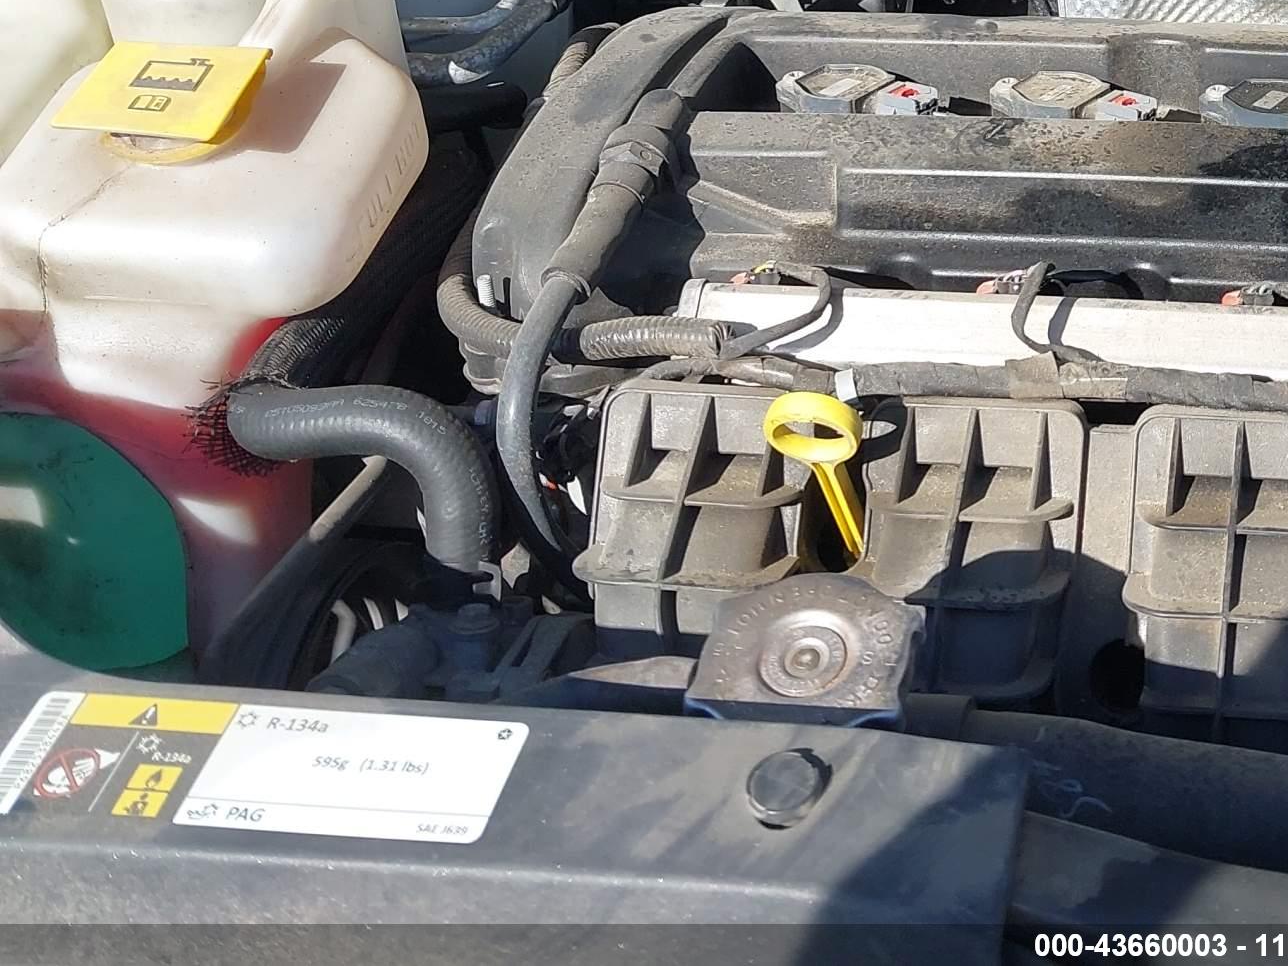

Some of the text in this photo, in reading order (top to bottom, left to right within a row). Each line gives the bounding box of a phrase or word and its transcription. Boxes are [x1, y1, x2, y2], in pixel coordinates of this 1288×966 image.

[266, 716, 329, 733] R-134a
[151, 751, 192, 764] R-134a
[312, 755, 429, 775] 595g (1.31 lbs)
[226, 807, 265, 822] PAG
[416, 823, 468, 835] SAE J639
